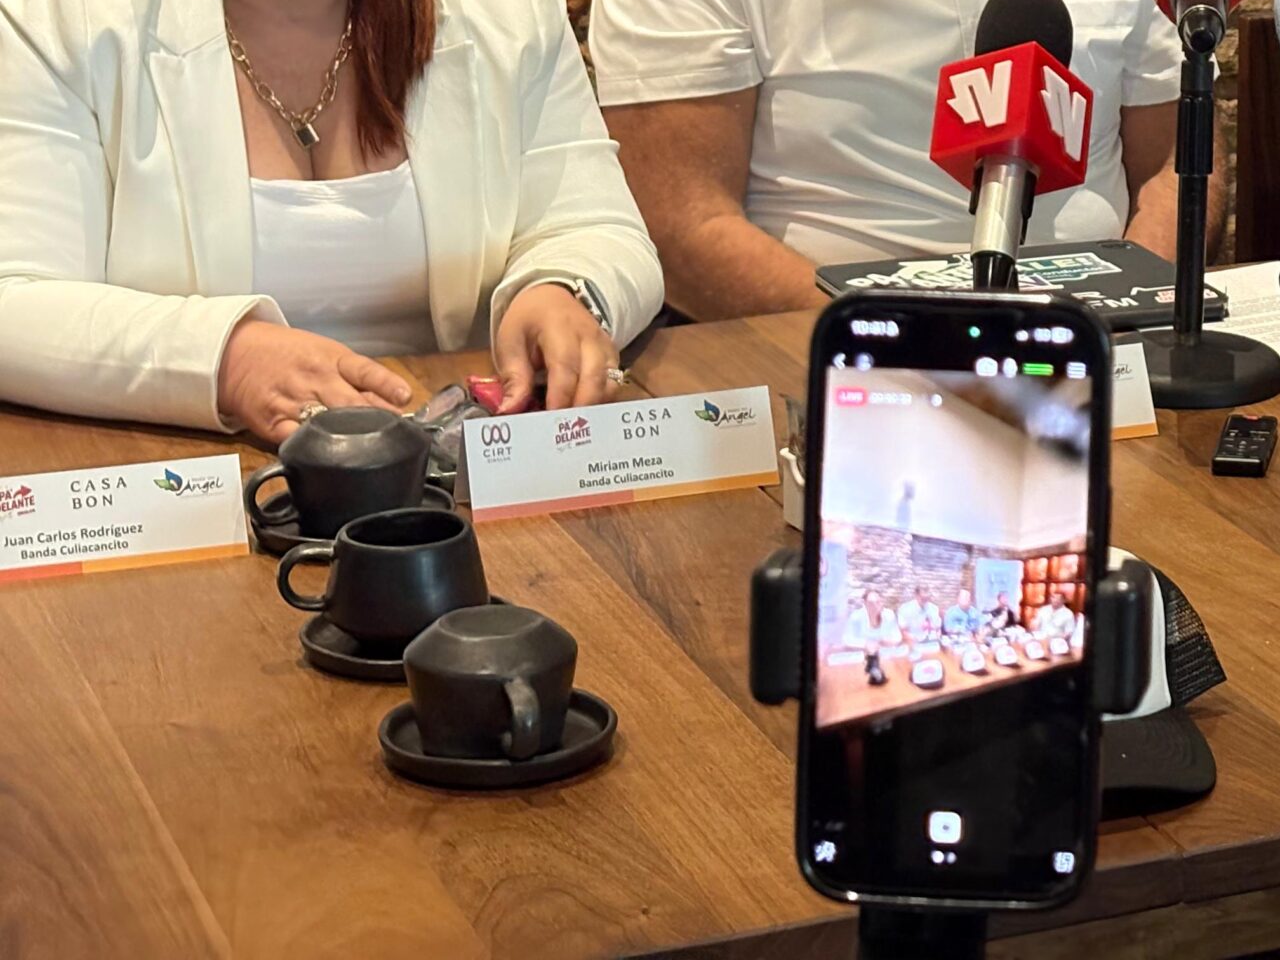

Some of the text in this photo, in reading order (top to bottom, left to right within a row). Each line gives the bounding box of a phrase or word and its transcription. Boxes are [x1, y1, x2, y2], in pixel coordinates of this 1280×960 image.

[621, 407, 672, 424] CASA
[555, 426, 592, 445] DELANTE
[623, 425, 660, 440] BON
[483, 446, 512, 458] CIRT
[588, 455, 663, 474] Miriam Meza
[70, 476, 128, 493] CASA
[579, 469, 674, 489] Banda Culiacancito
[0, 496, 35, 512] ELANTE
[72, 494, 114, 510] BON
[3, 522, 144, 548] Juan Carlos Rodríguez
[20, 540, 129, 560] Banda Culiacancito
